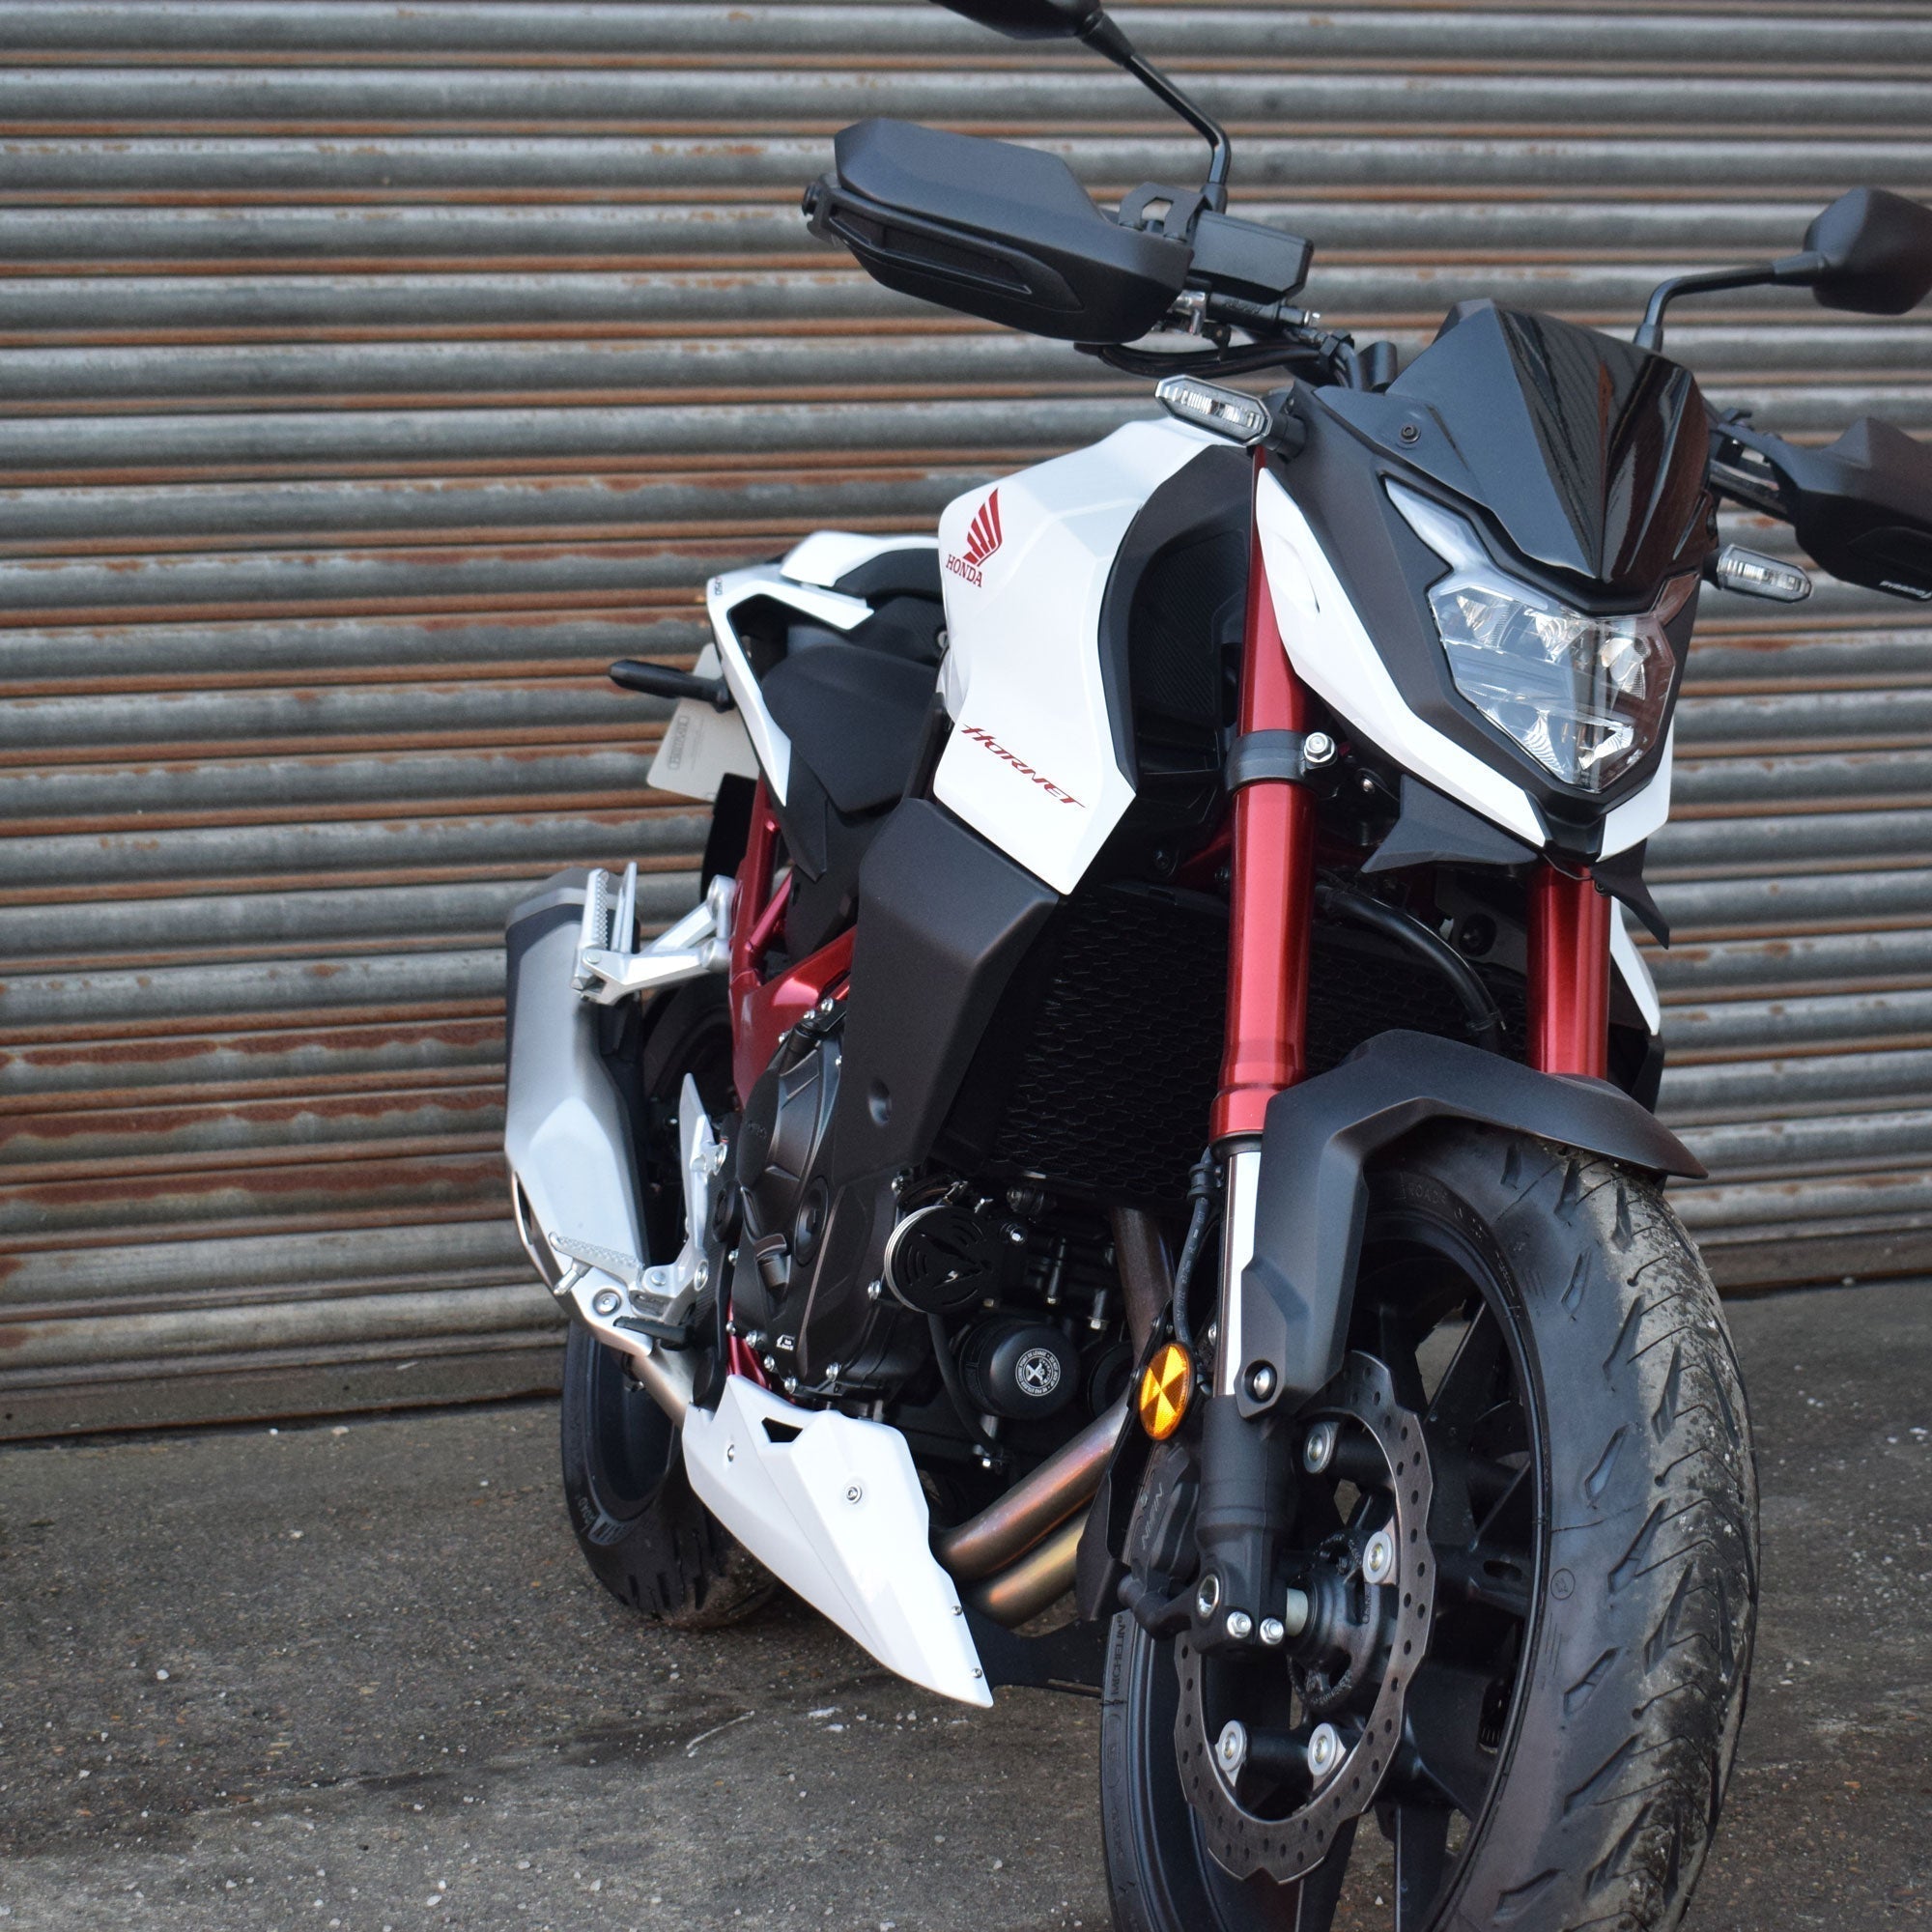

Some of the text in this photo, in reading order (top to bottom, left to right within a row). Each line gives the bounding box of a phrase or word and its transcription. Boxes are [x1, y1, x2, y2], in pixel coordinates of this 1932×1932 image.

[946, 554, 982, 588] HONDA
[959, 723, 1087, 810] HORNET
[1112, 1625, 1125, 1696] MICHELIN
